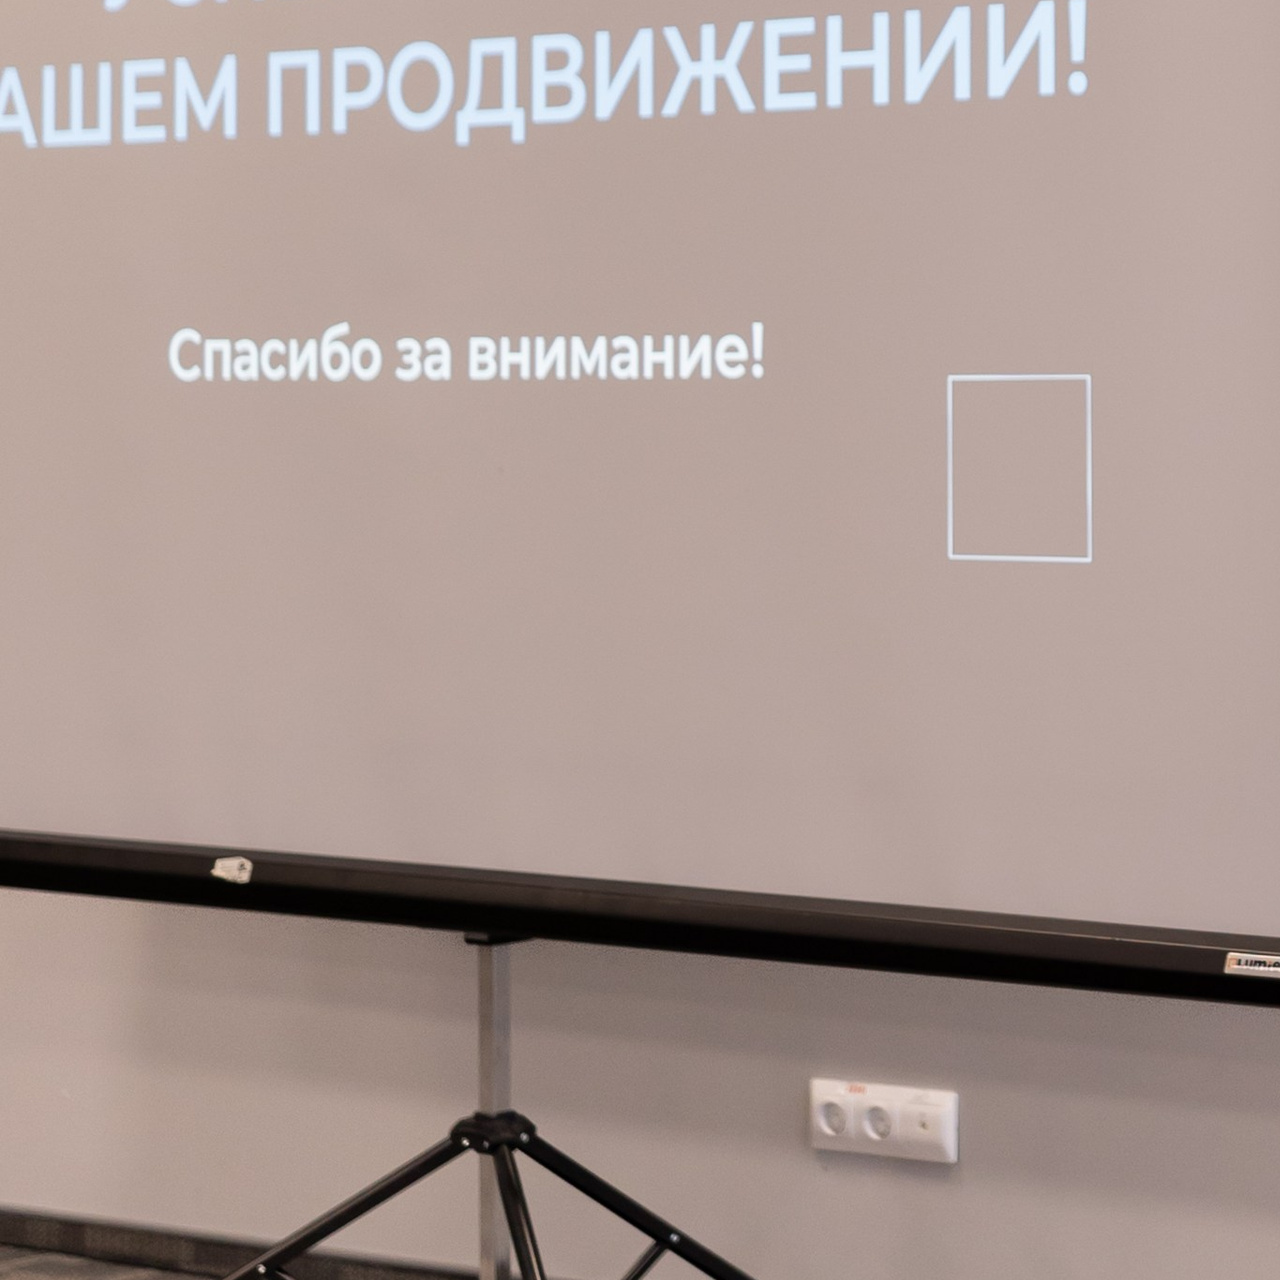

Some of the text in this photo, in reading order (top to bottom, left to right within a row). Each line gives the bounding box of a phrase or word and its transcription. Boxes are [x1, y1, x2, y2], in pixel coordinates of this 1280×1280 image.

[167, 320, 765, 383] Спасибо за внимание!
